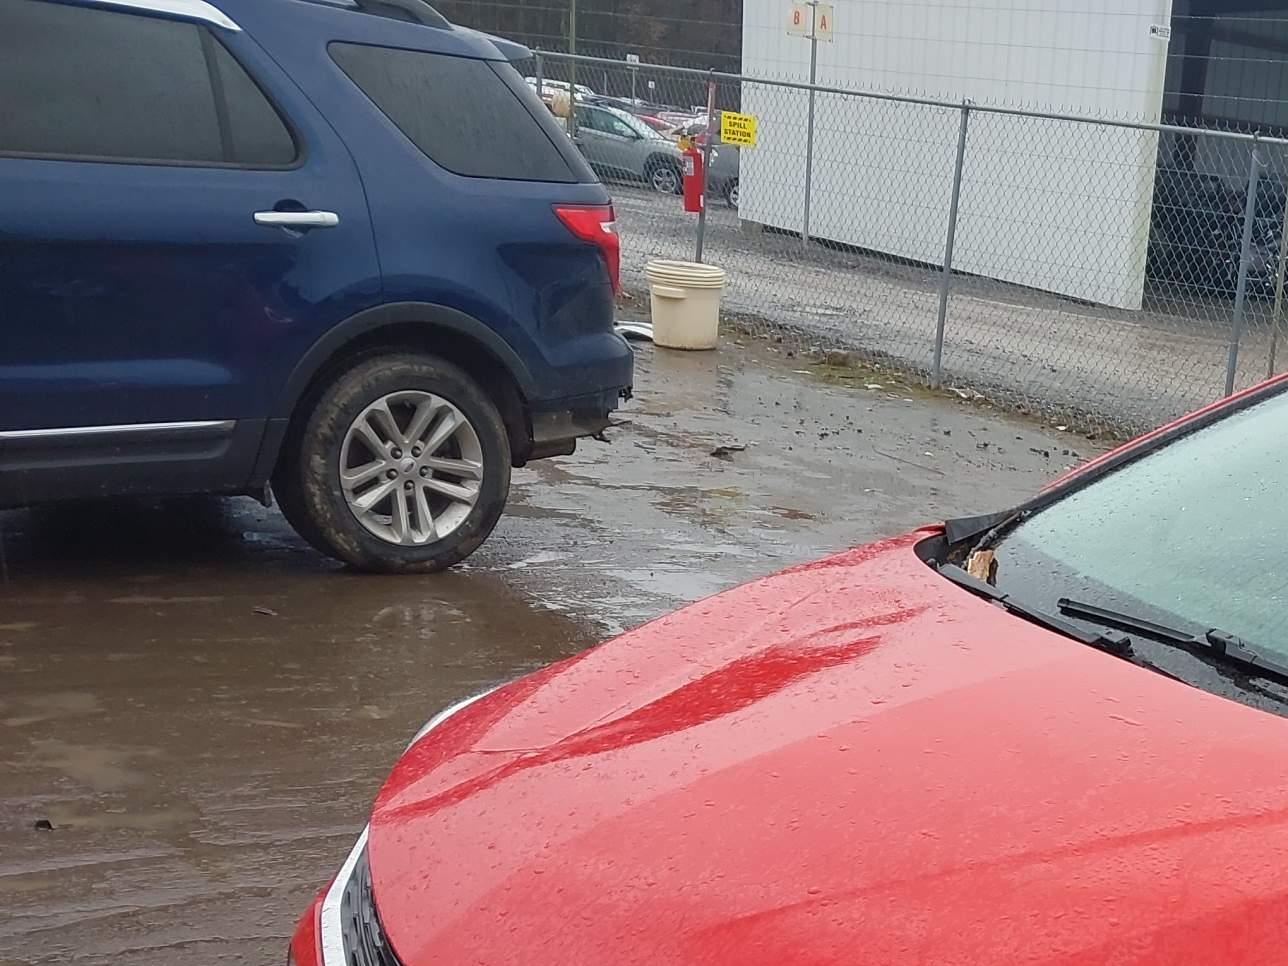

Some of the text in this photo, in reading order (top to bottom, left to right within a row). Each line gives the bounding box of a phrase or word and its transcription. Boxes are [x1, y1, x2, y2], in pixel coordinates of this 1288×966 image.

[793, 10, 801, 25] B
[819, 15, 827, 31] A
[728, 120, 747, 130] SPILL
[723, 128, 751, 138] STATION
